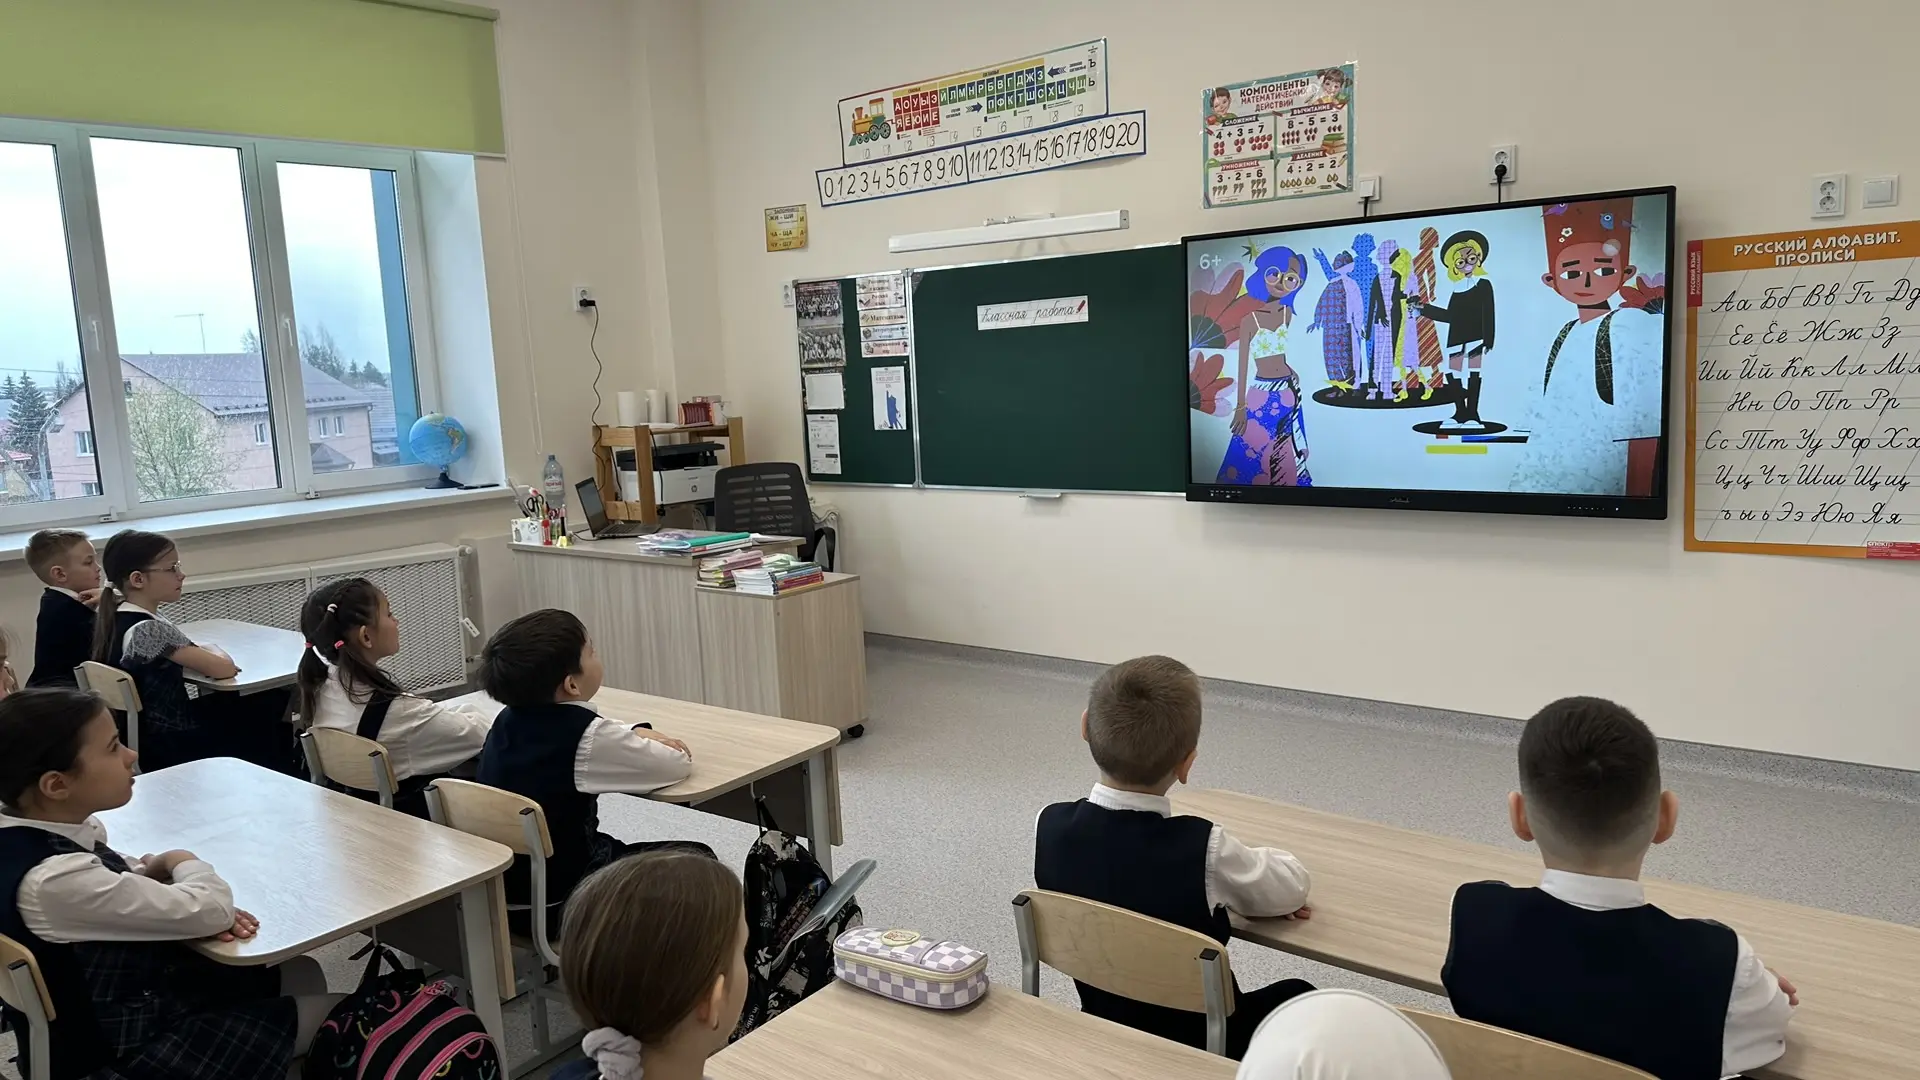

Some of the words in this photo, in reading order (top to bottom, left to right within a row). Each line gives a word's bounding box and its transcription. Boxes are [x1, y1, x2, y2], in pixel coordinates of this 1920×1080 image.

[1239, 78, 1310, 97] КОМПОНЕНТЫ
[1255, 99, 1294, 112] ДЕЙСТВИЙ
[969, 150, 981, 175] 11
[983, 147, 998, 171] 12
[1000, 145, 1015, 168] 13
[1016, 142, 1032, 166] 14
[1033, 138, 1049, 163] 15
[1050, 134, 1064, 160] 16
[1066, 131, 1081, 157] 17
[1082, 127, 1097, 153] 18
[1099, 124, 1116, 150] 19
[1115, 121, 1140, 148] 20
[824, 177, 834, 198] 0
[837, 175, 844, 196] 1
[847, 173, 856, 195] 2
[860, 171, 869, 193] 3
[872, 169, 881, 190] 4
[885, 166, 895, 188] 5
[899, 164, 908, 186] 6
[911, 162, 920, 184] 7
[923, 159, 932, 182] 8
[936, 157, 946, 180] 9
[949, 154, 964, 178] 10
[1733, 236, 1807, 258] РУССКИЙ
[1812, 231, 1901, 250] АЛФАВИТ.
[1200, 253, 1222, 270] 6+
[1775, 249, 1856, 267] ПРОПИСИ
[981, 307, 1028, 323] Классная
[1032, 300, 1075, 324] работа
